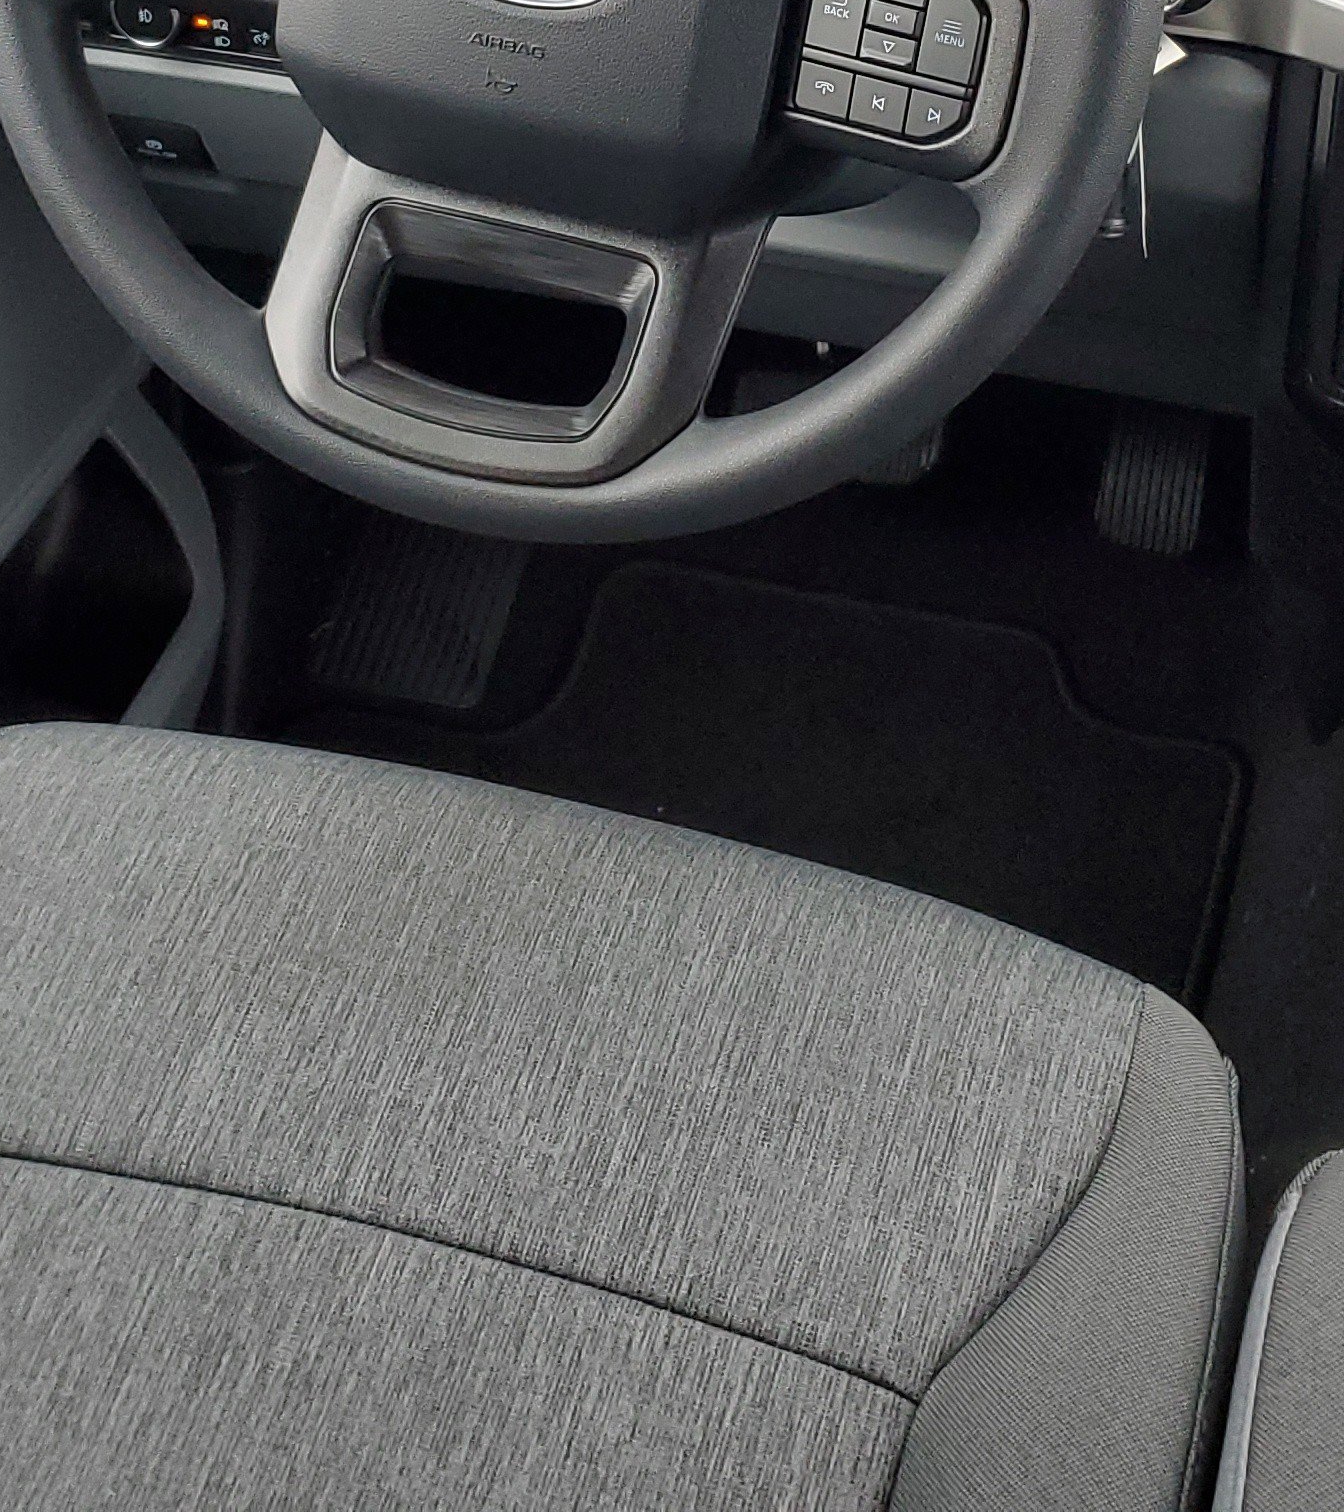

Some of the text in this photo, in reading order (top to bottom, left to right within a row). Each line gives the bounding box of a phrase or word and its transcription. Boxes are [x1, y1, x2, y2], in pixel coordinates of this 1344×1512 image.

[823, 4, 850, 19] BACK
[884, 12, 900, 25] OK
[468, 32, 548, 60] AIRBAG
[934, 32, 965, 48] MENU
